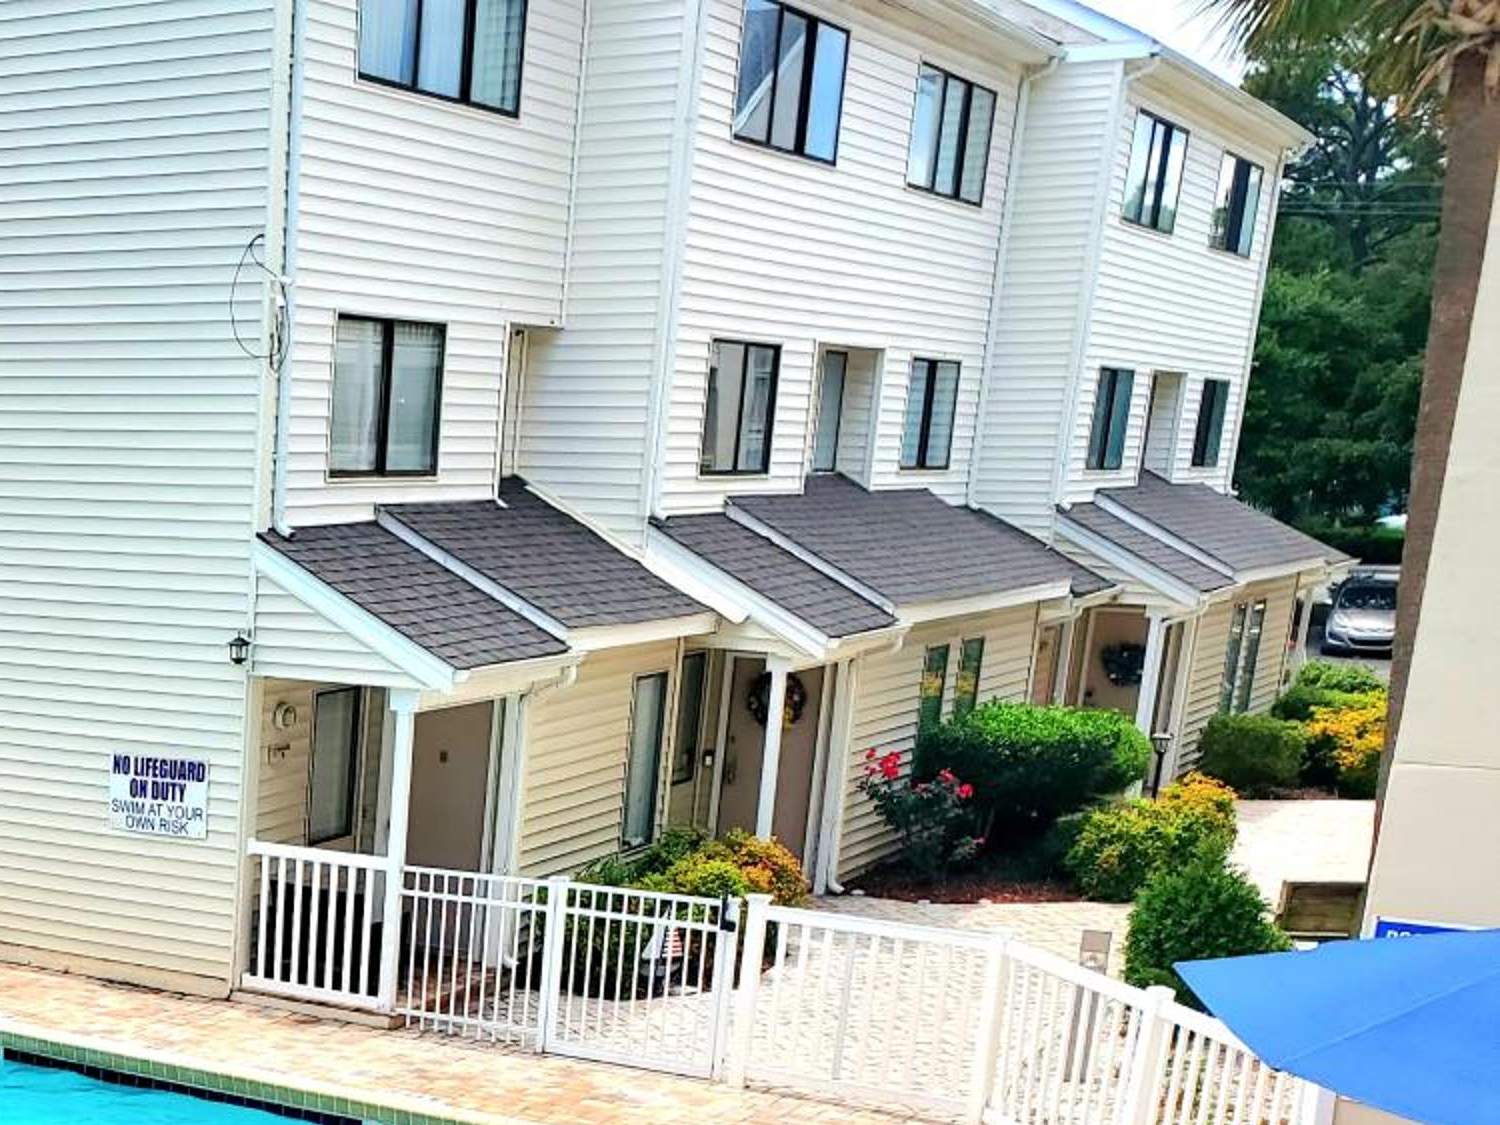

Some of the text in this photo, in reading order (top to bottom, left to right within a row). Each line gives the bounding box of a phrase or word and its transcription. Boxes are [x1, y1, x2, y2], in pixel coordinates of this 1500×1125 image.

[113, 753, 206, 783] NO LIFEGUARD
[129, 777, 186, 803] ON DUTY
[111, 798, 203, 821] SWIM AT YOUR
[125, 814, 189, 835] OWN RISK
